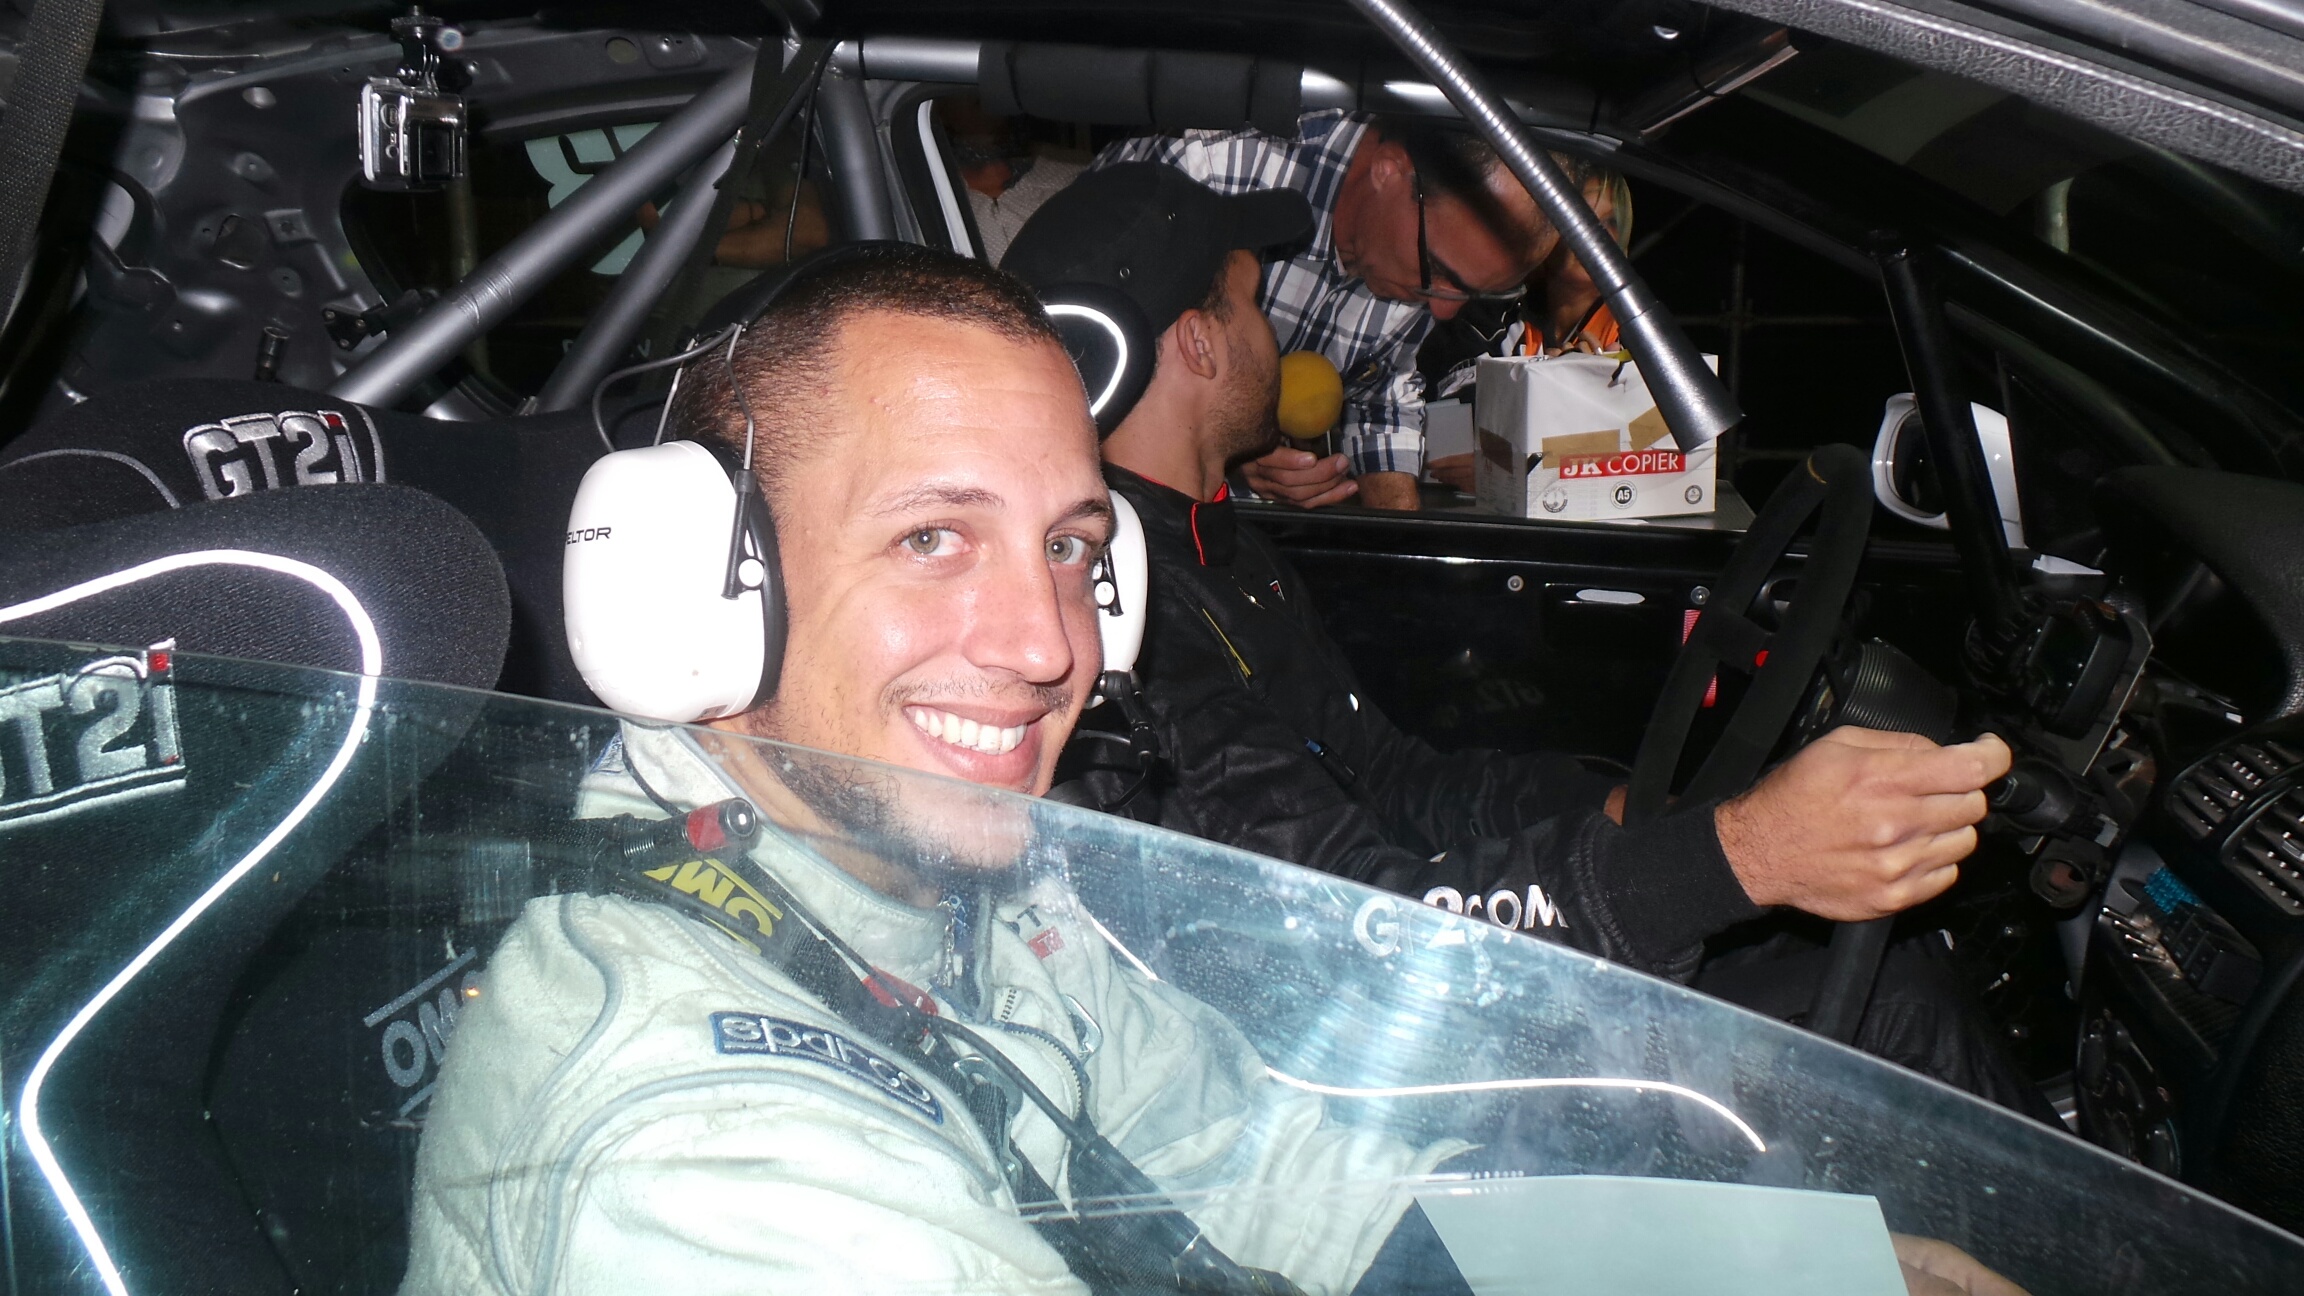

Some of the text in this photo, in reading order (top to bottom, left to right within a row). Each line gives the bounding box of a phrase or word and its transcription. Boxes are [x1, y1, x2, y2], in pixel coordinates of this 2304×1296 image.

[183, 410, 362, 500] GT2i
[1564, 452, 1679, 476] JK COPIER
[1616, 489, 1631, 502] A5
[566, 526, 612, 545] ELTOR
[0, 638, 180, 798] T2i
[721, 1015, 931, 1102] sparco
